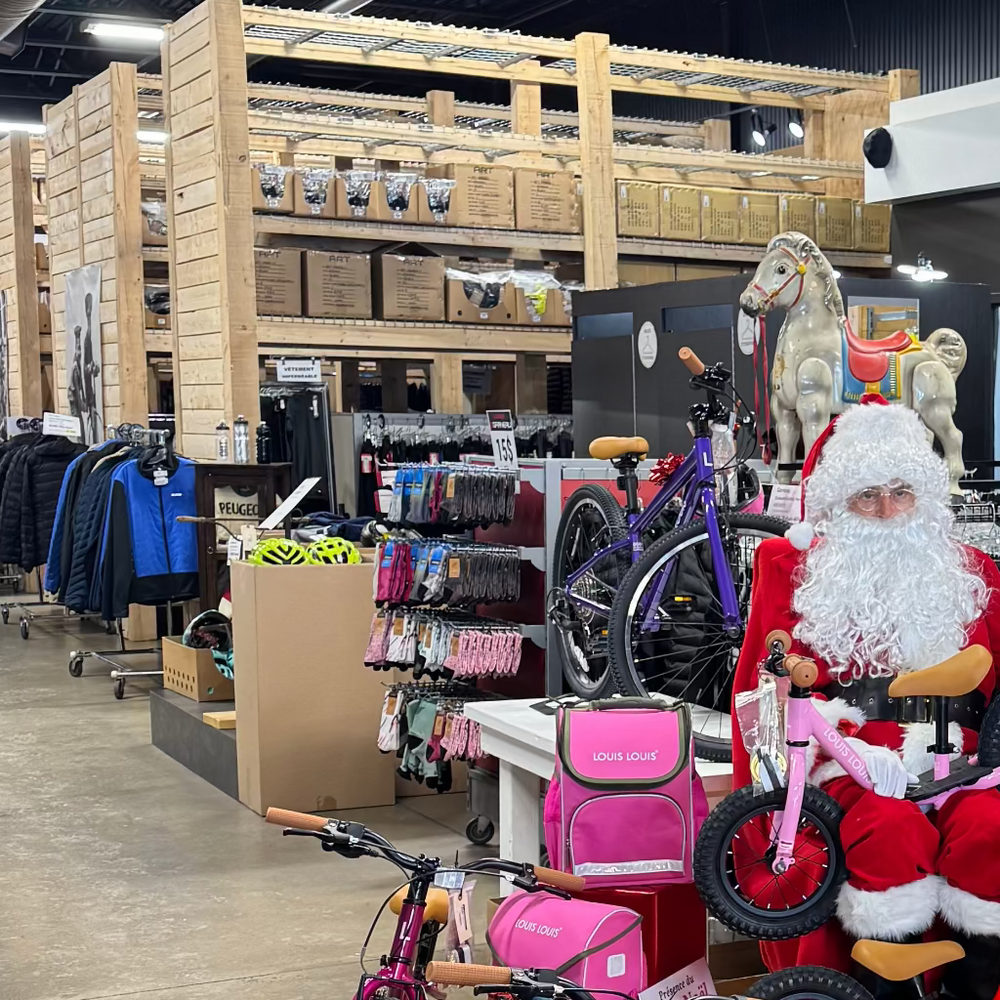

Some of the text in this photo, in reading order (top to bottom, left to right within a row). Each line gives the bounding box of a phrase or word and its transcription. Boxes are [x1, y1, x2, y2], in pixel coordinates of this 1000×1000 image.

[496, 436, 513, 463] 15$
[703, 452, 713, 466] L
[219, 502, 258, 516] PEUGEO
[823, 727, 849, 756] LOUIS
[593, 751, 624, 761] LOUIS
[515, 918, 537, 932] LOUIS
[686, 975, 694, 985] du
